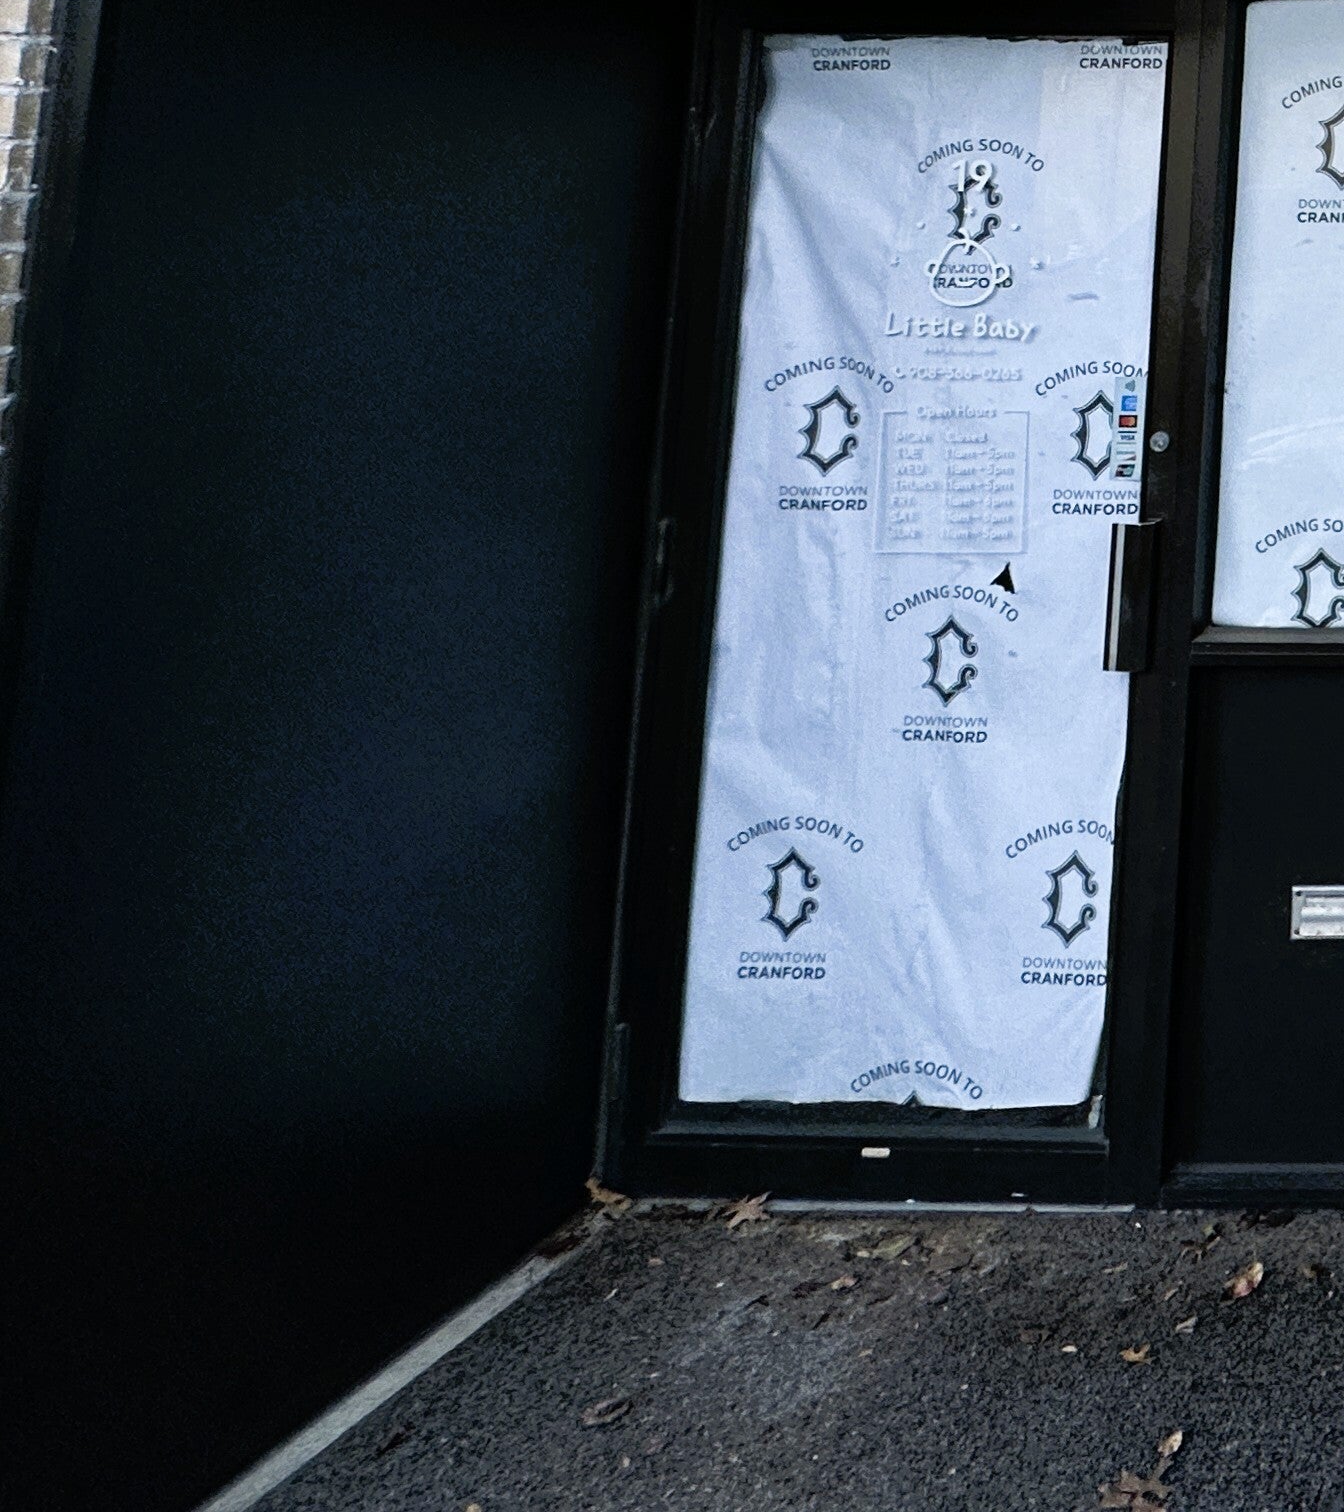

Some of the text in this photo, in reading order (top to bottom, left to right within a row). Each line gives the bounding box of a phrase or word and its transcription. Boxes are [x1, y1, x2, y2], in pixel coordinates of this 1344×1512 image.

[812, 47, 890, 58] DOWNTOWN
[1081, 44, 1162, 55] DOWNTOWN
[813, 60, 891, 71] CRANFORD
[1080, 57, 1163, 69] CRANFORD
[1281, 75, 1344, 110] COMING
[918, 139, 1044, 173] COMING SOON TO
[952, 159, 992, 192] 19
[884, 312, 1036, 343] Little Baby
[764, 355, 894, 394] COMING SOON TO
[1035, 361, 1098, 396] COMING
[780, 484, 868, 496] DOWNTOWN
[1054, 489, 1137, 499] DOWNTOWN
[778, 498, 868, 511] CRANFORD
[1052, 503, 1138, 515] CRANFORD
[1254, 519, 1320, 555] COMING
[885, 585, 1019, 622] COMING SOON TO
[903, 715, 988, 727] DOWNTOWN
[902, 729, 988, 743] CRANFORD
[727, 816, 864, 852] COMING SOON TO
[1005, 820, 1073, 859] COMING
[739, 952, 827, 963] DOWNTOWN
[1023, 957, 1108, 970] DOWNTOWN
[737, 966, 826, 980] CRANFORD
[1021, 971, 1108, 986] CRANFORD
[851, 1060, 982, 1099] COMING SOON TO
